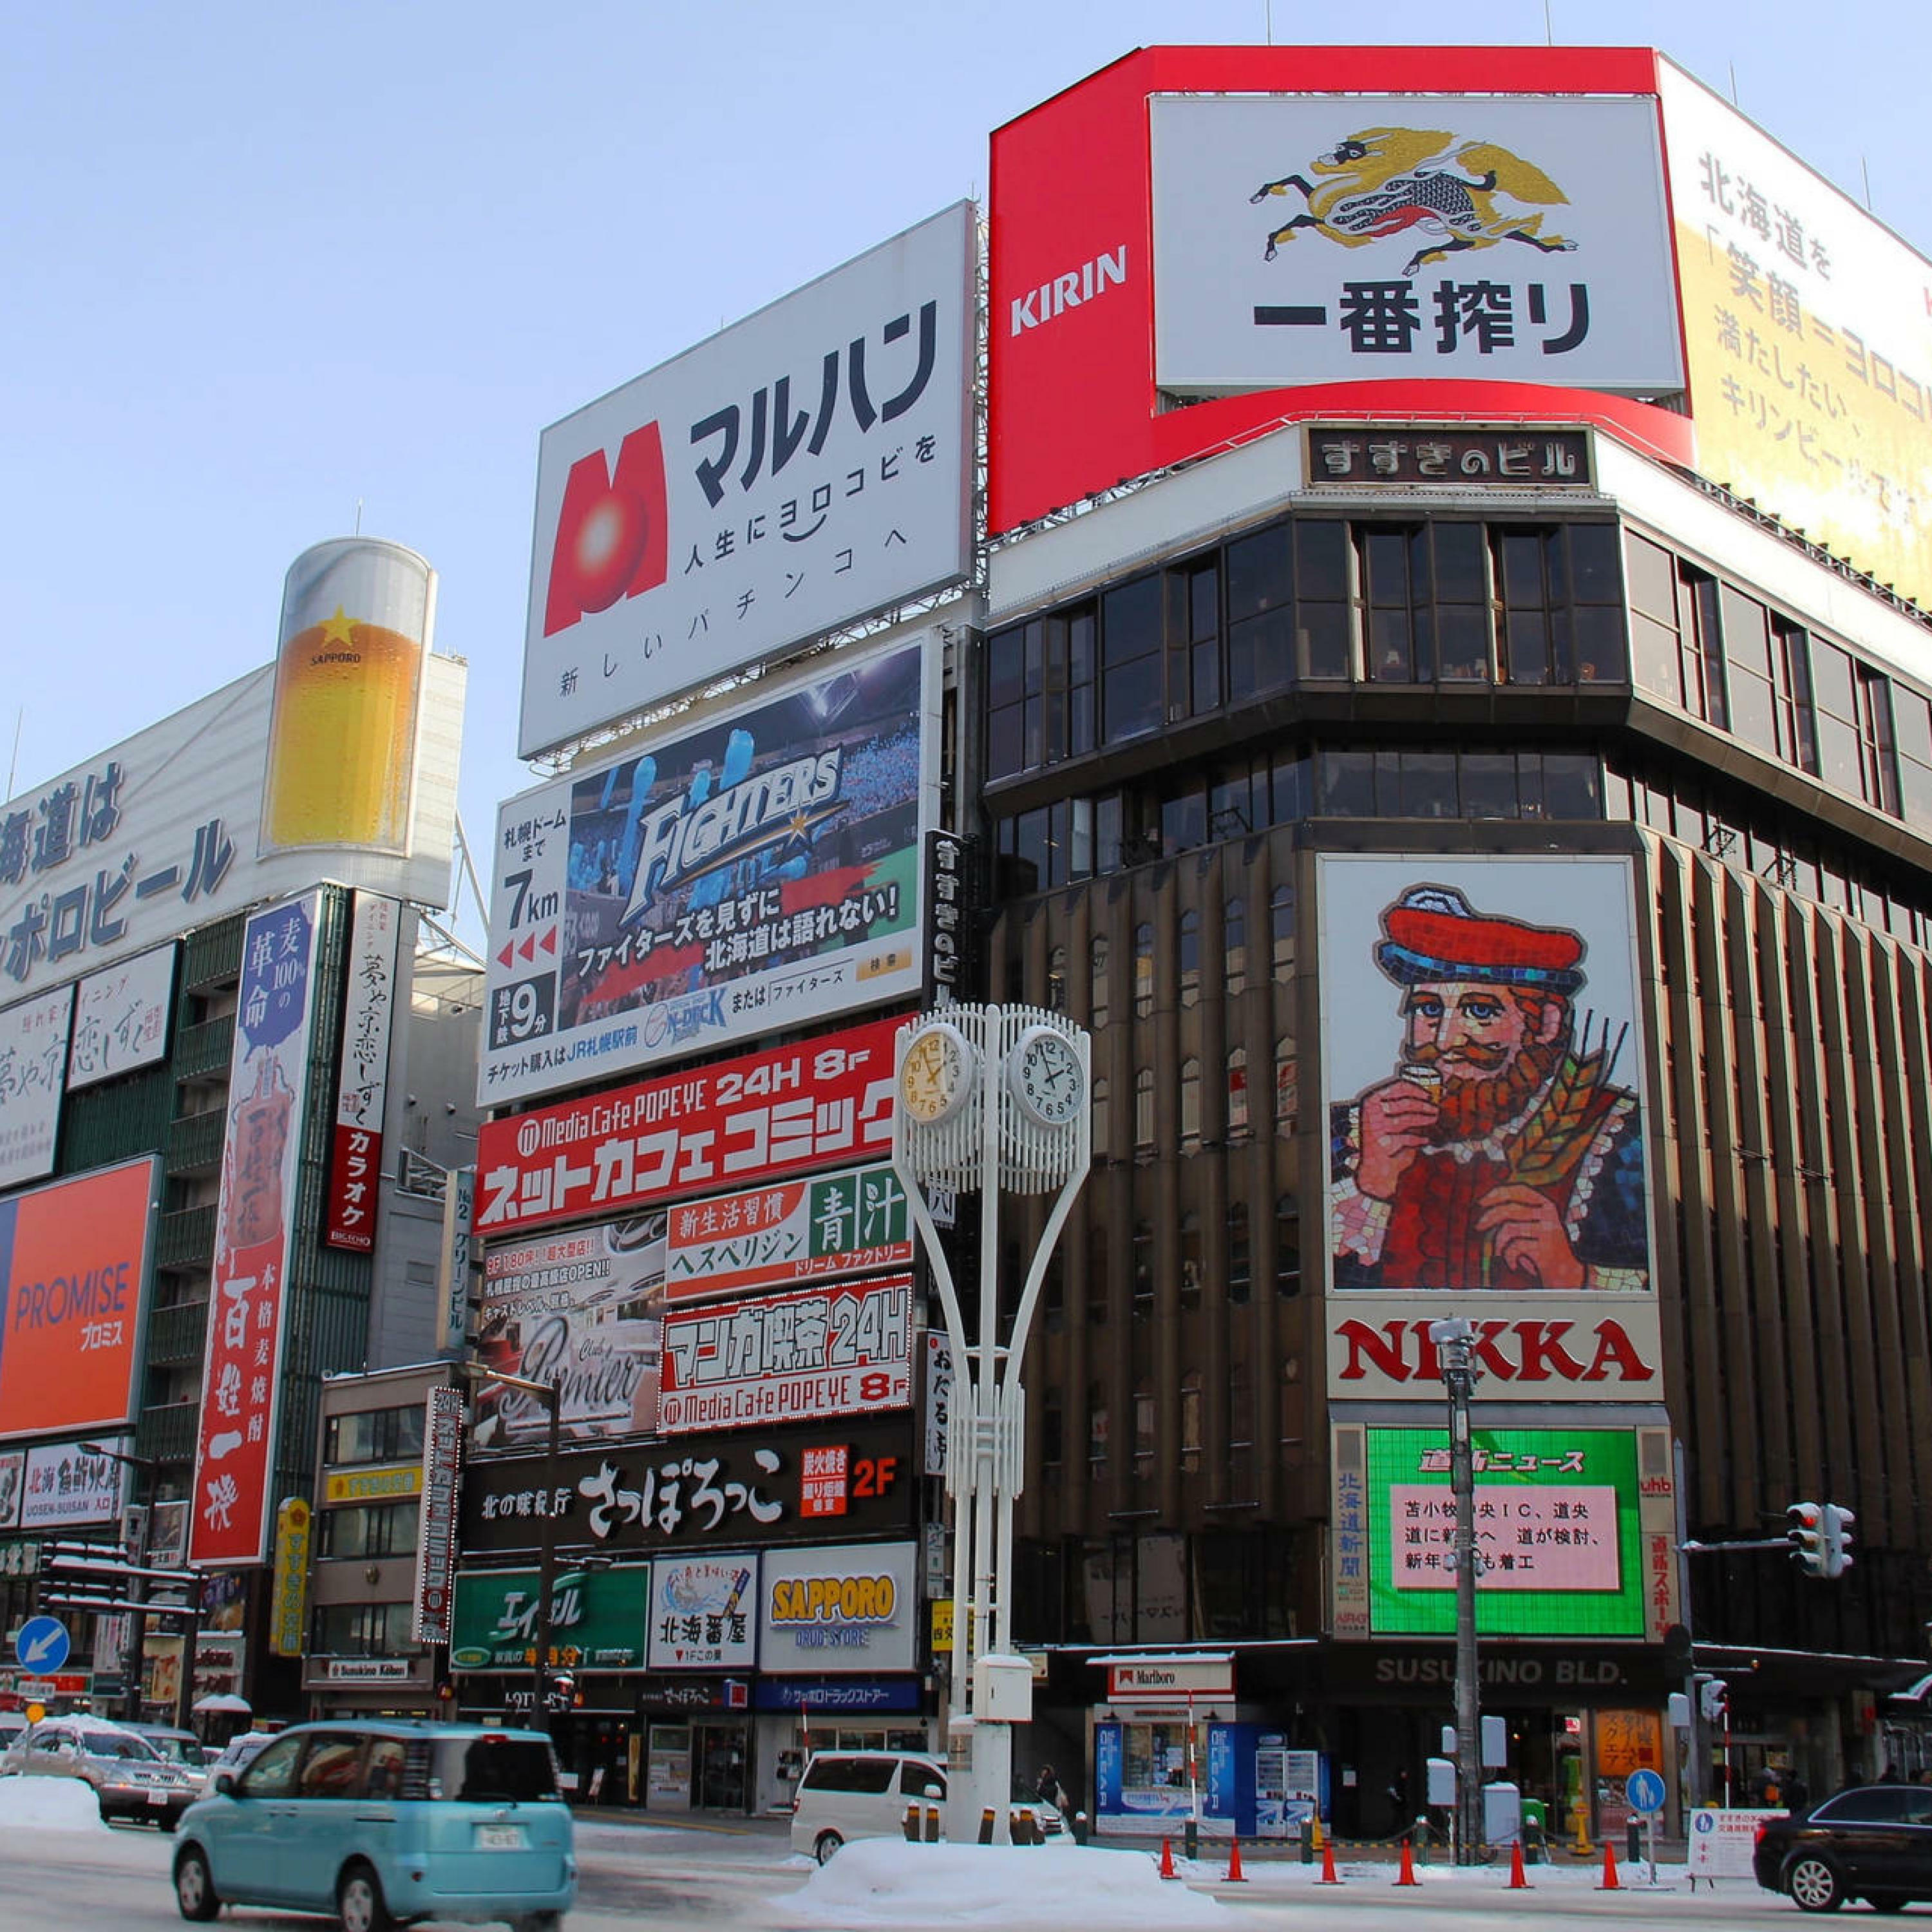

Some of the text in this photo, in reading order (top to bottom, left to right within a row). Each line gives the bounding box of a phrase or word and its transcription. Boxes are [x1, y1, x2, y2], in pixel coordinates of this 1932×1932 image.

[1010, 245, 1127, 338] KIRIN
[1254, 279, 1589, 355] 一番搾り
[690, 299, 937, 509] マルハン
[685, 434, 936, 575] 人生にヨロコビを
[560, 528, 907, 697] 新しいパチンコへ
[310, 653, 361, 665] SAPPORO
[504, 809, 566, 849] 札幌ドーム
[522, 838, 546, 862] まで
[620, 747, 844, 927] FIGHTERS
[0, 819, 236, 983] ポロビール
[705, 886, 897, 971] 北海道は語れない!
[578, 888, 781, 979] ファイターズを見ずに
[245, 931, 276, 1029] 革命
[732, 969, 844, 1014] または ファイターズ
[541, 1048, 871, 1149] Media Cafe POPEYE 24H 8F
[341, 1132, 372, 1227] カラオケ
[679, 1191, 784, 1240] 新生活習慣
[814, 1177, 905, 1251] 青汁
[672, 1229, 806, 1274] ヘスペリジン
[15, 1261, 131, 1333] PROMISE
[80, 1321, 124, 1352] プロミス
[1334, 1318, 1655, 1383] NIKKA
[685, 1372, 907, 1424] Media Cafe POPEYE 8F
[578, 1448, 782, 1539] さっぽろっこ
[853, 1455, 897, 1497] 2F
[1641, 1477, 1672, 1492] uhb
[1338, 1473, 1363, 1577] 北海道新聞
[1405, 1500, 1589, 1519] 苫小牧央IC、道央
[1405, 1527, 1496, 1545] 道に新へ
[1405, 1552, 1535, 1570] 新年も着工
[771, 1575, 895, 1621] SAPPORO
[794, 1628, 869, 1647] DRUG STORE
[1137, 1669, 1175, 1685] Marlboro
[1555, 1660, 1629, 1685] BLD.
